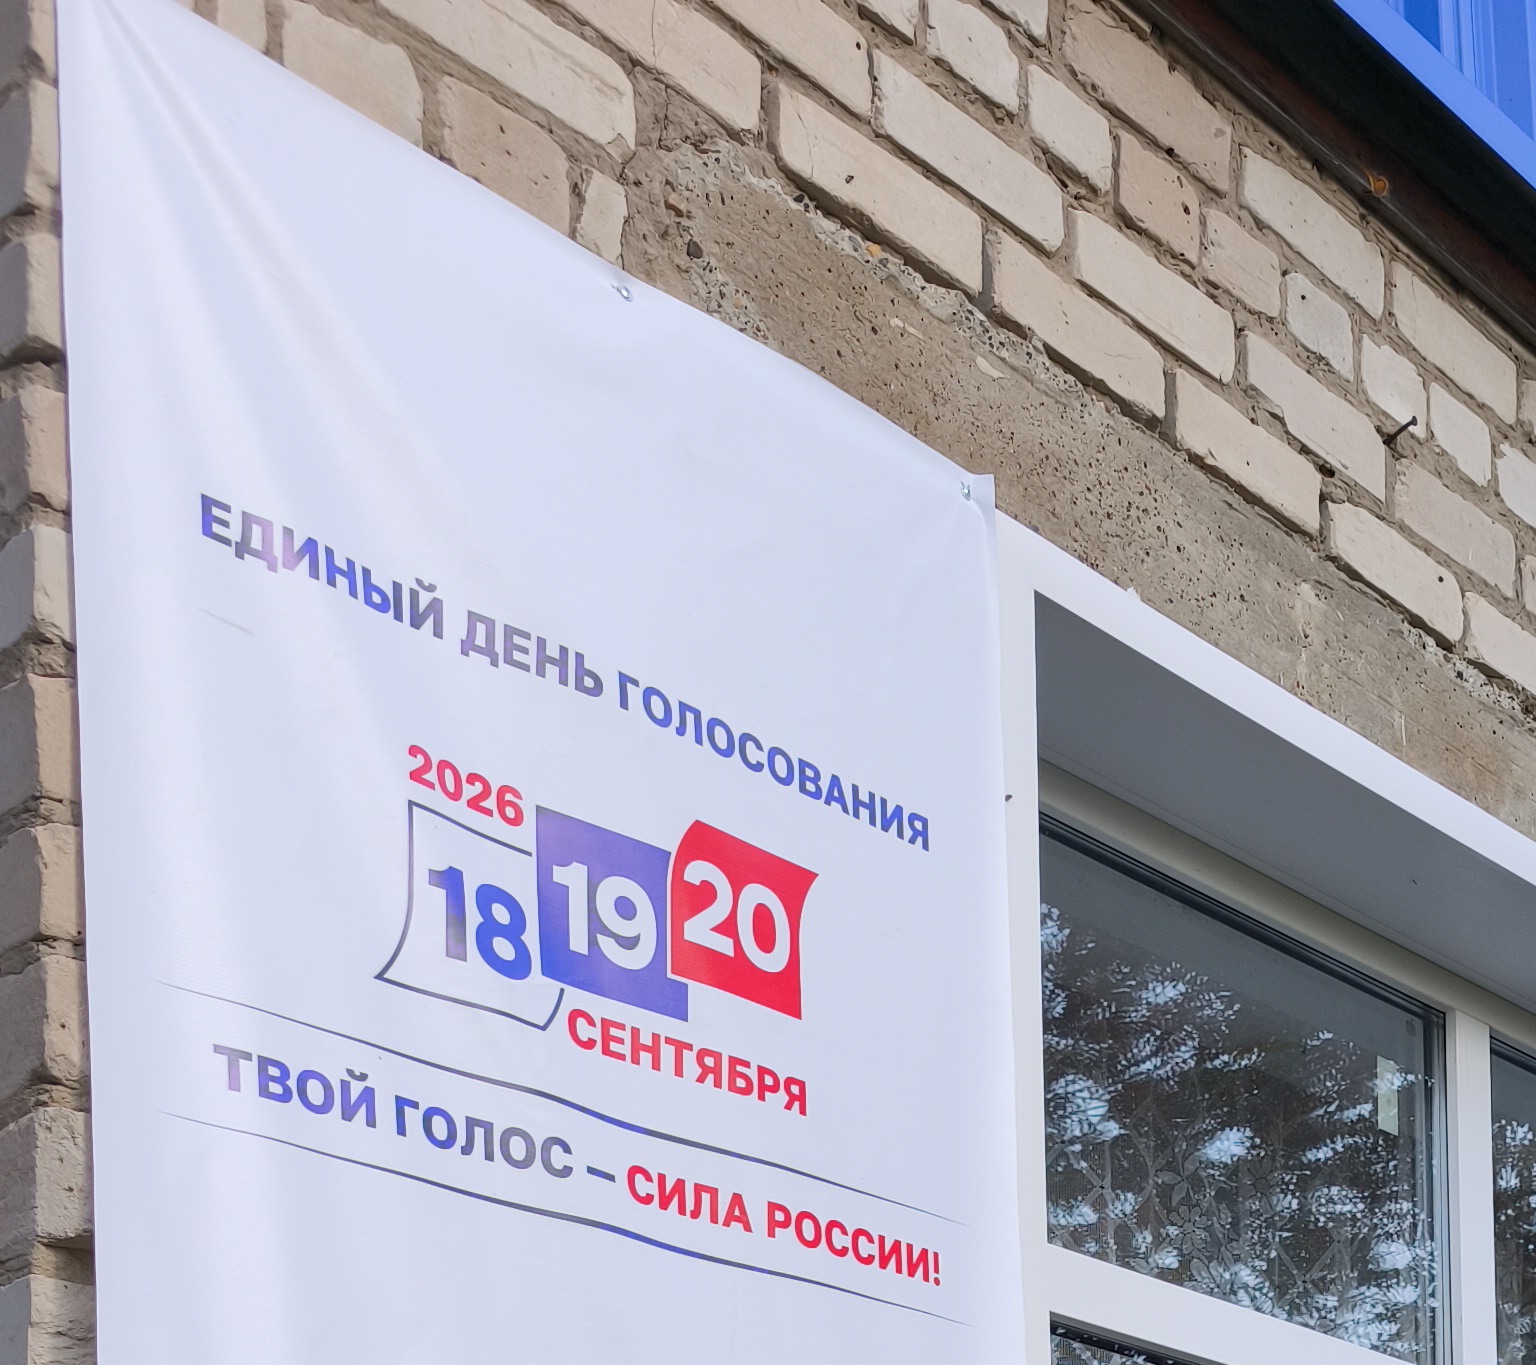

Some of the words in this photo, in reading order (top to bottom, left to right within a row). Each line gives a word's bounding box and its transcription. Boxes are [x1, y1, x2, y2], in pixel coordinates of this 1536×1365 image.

[200, 493, 445, 640] ЕДИНЫЙ
[461, 609, 603, 698] ДЕНЬ
[617, 670, 930, 852] ГОЛОСОВАНИЯ
[407, 744, 524, 828] 2026
[428, 866, 533, 982] 18
[551, 861, 658, 972] 19
[682, 859, 792, 974] 20
[567, 1009, 809, 1117] СЕНТЯБРЯ
[213, 1043, 376, 1129] ТВОЙ
[394, 1094, 573, 1180] ГОЛОС
[626, 1164, 752, 1233] СИЛА
[767, 1210, 942, 1287] РОССИИ!
